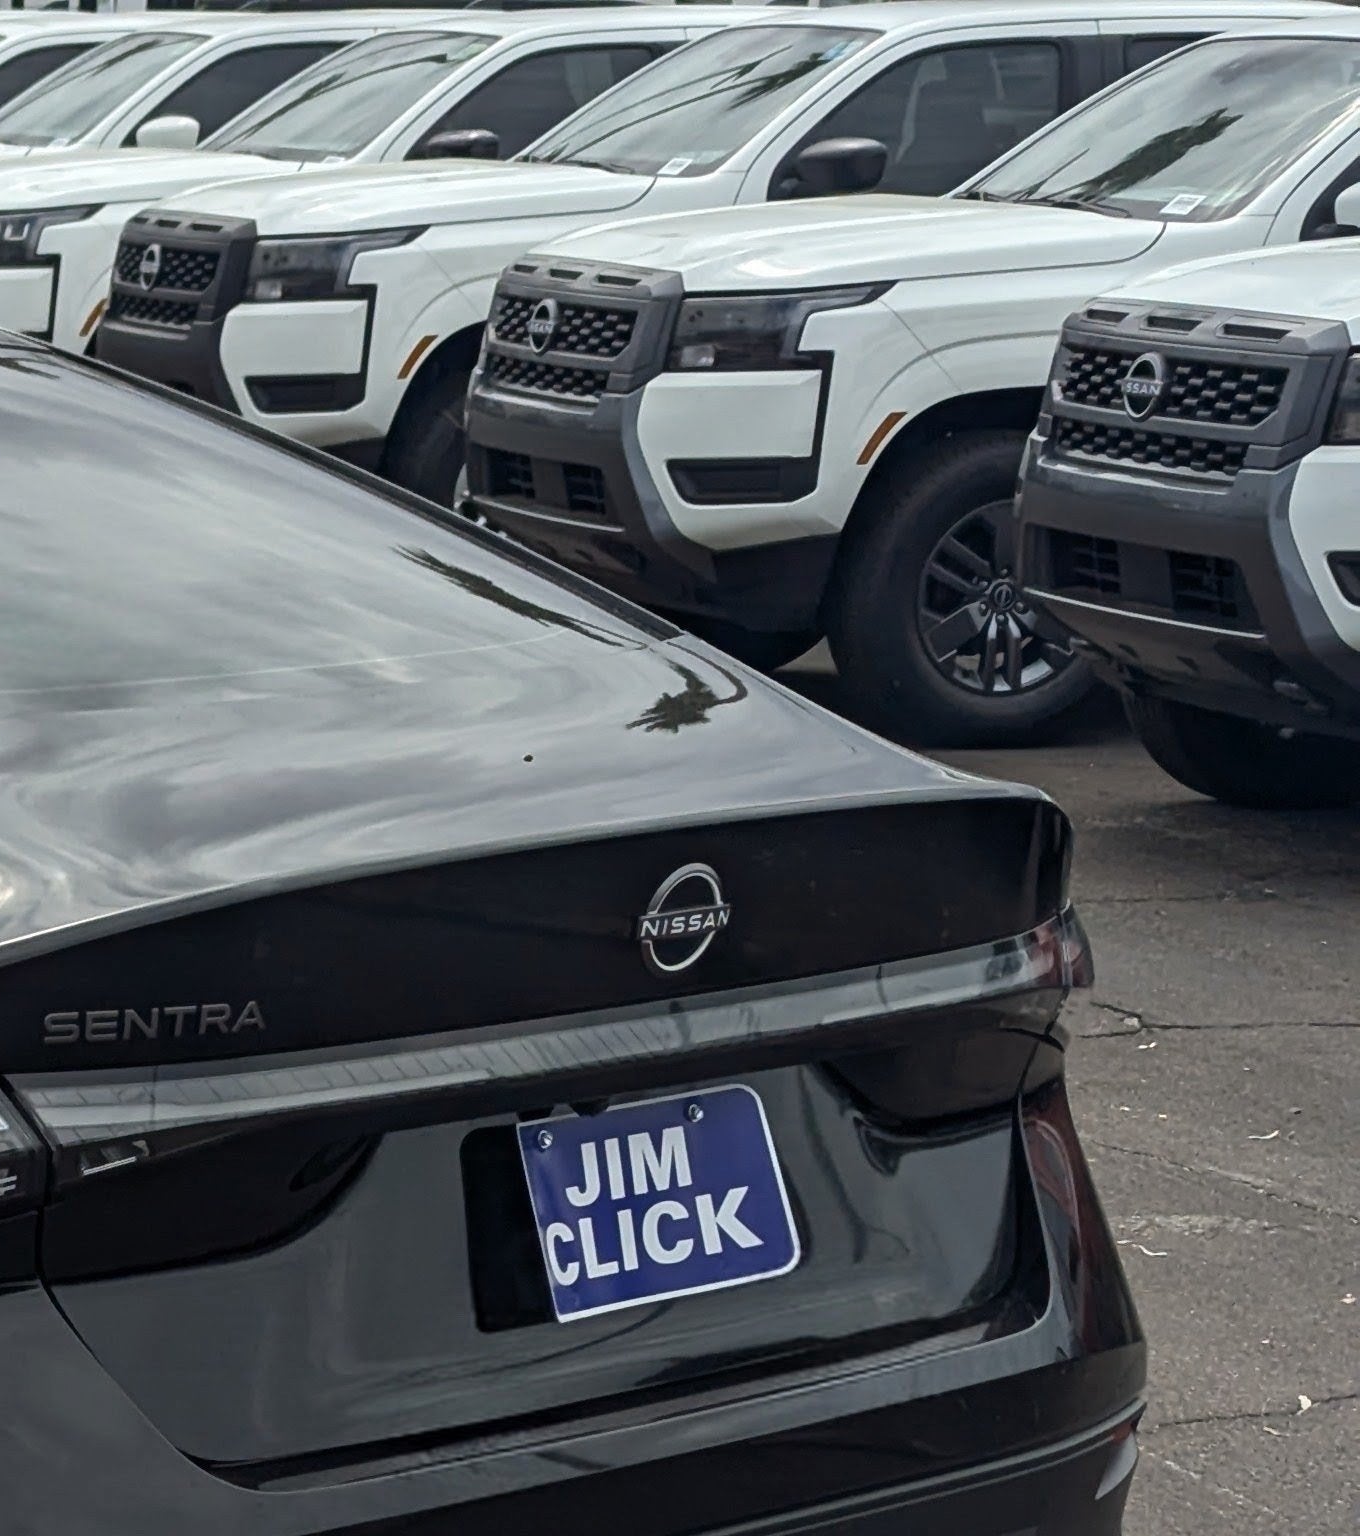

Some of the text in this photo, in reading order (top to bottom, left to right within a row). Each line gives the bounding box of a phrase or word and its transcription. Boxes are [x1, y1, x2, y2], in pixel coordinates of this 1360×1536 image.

[1120, 381, 1161, 395] SSAN
[641, 908, 730, 937] NISSAN
[43, 1000, 267, 1044] SENTRA
[565, 1126, 692, 1207] JIM
[546, 1186, 764, 1286] CLICK
